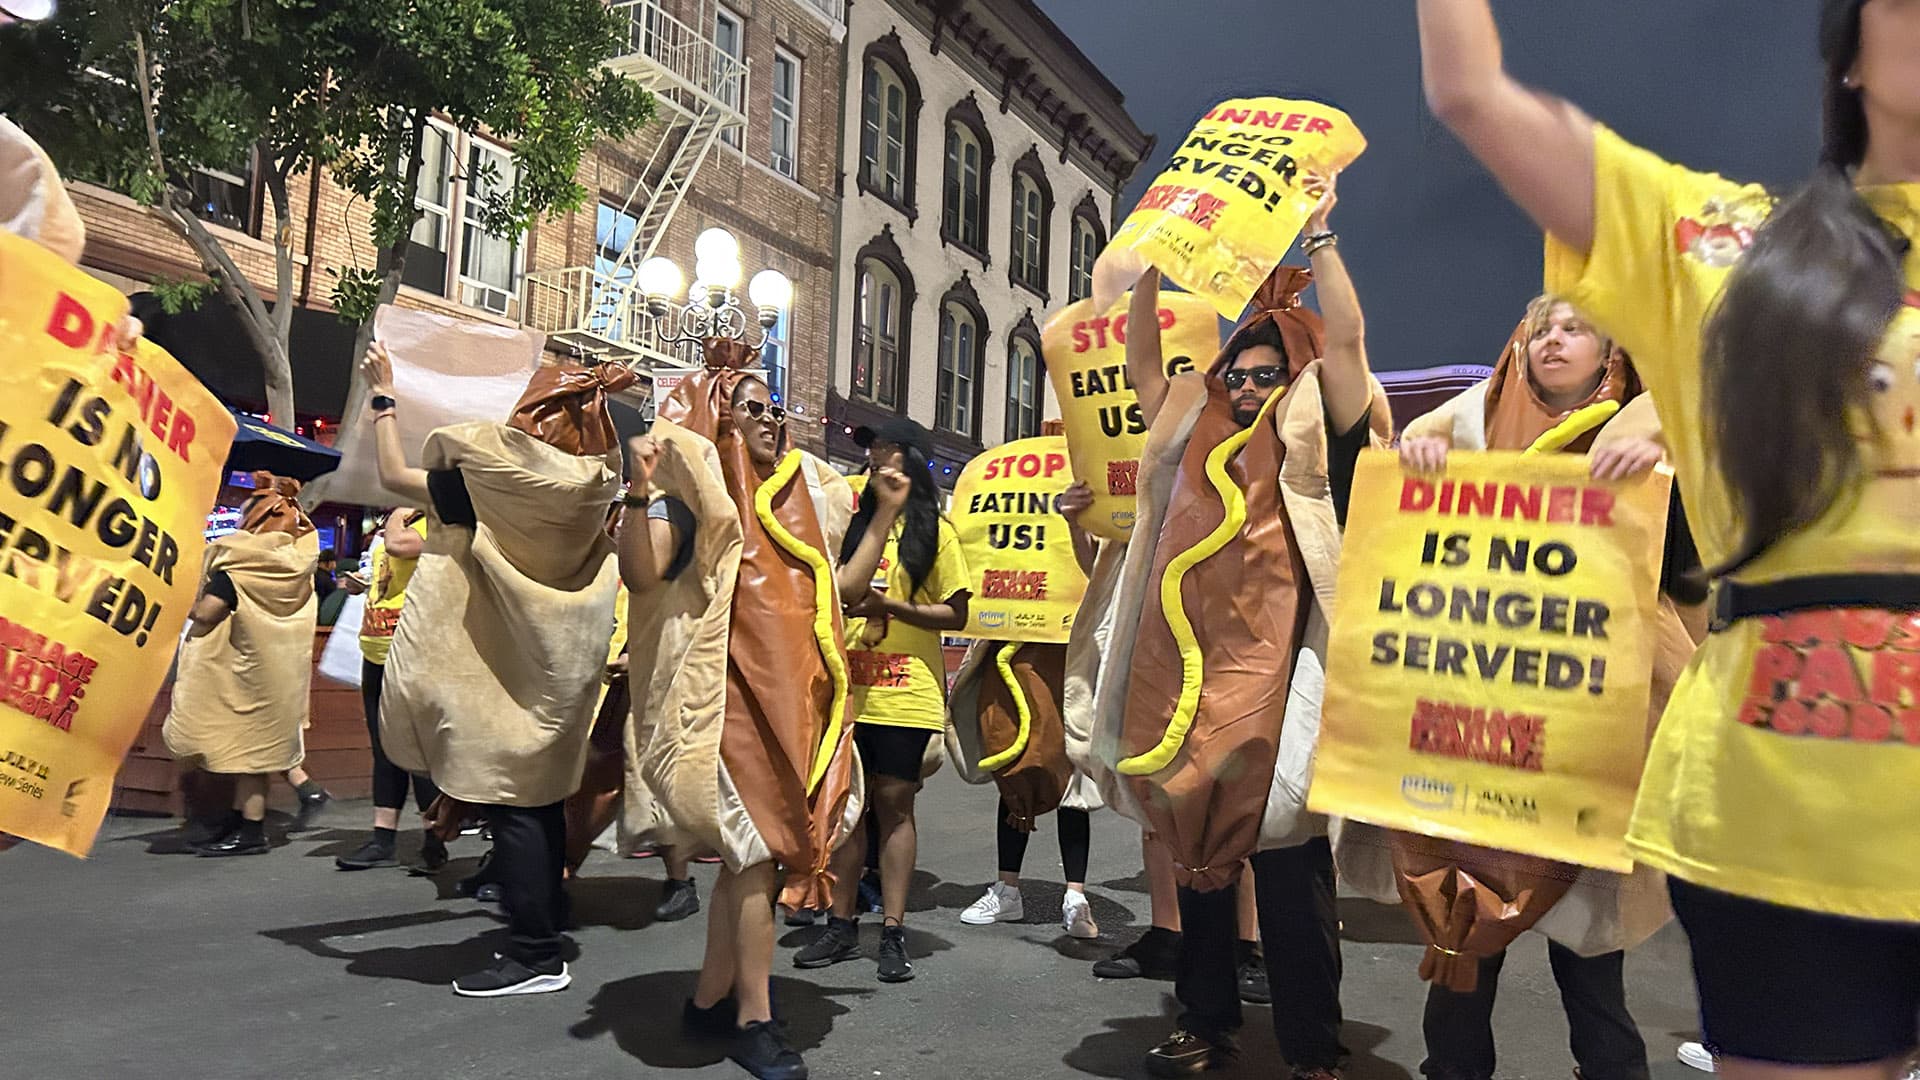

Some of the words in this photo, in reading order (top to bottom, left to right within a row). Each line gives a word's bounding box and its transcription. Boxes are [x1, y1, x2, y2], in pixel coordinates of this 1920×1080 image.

[1204, 109, 1334, 136] INNER
[1227, 132, 1294, 146] NO
[1171, 156, 1282, 213] RVED!
[1185, 137, 1298, 187] NGER
[47, 377, 112, 447] IS
[982, 453, 1066, 480] STOP
[0, 420, 179, 586] ONGER
[1399, 478, 1615, 527] DINNER
[988, 524, 1046, 551] US!
[1420, 530, 1470, 569] IS
[1487, 535, 1578, 577] NO
[1378, 577, 1610, 640] LONGER
[1370, 631, 1606, 696] SERVED!
